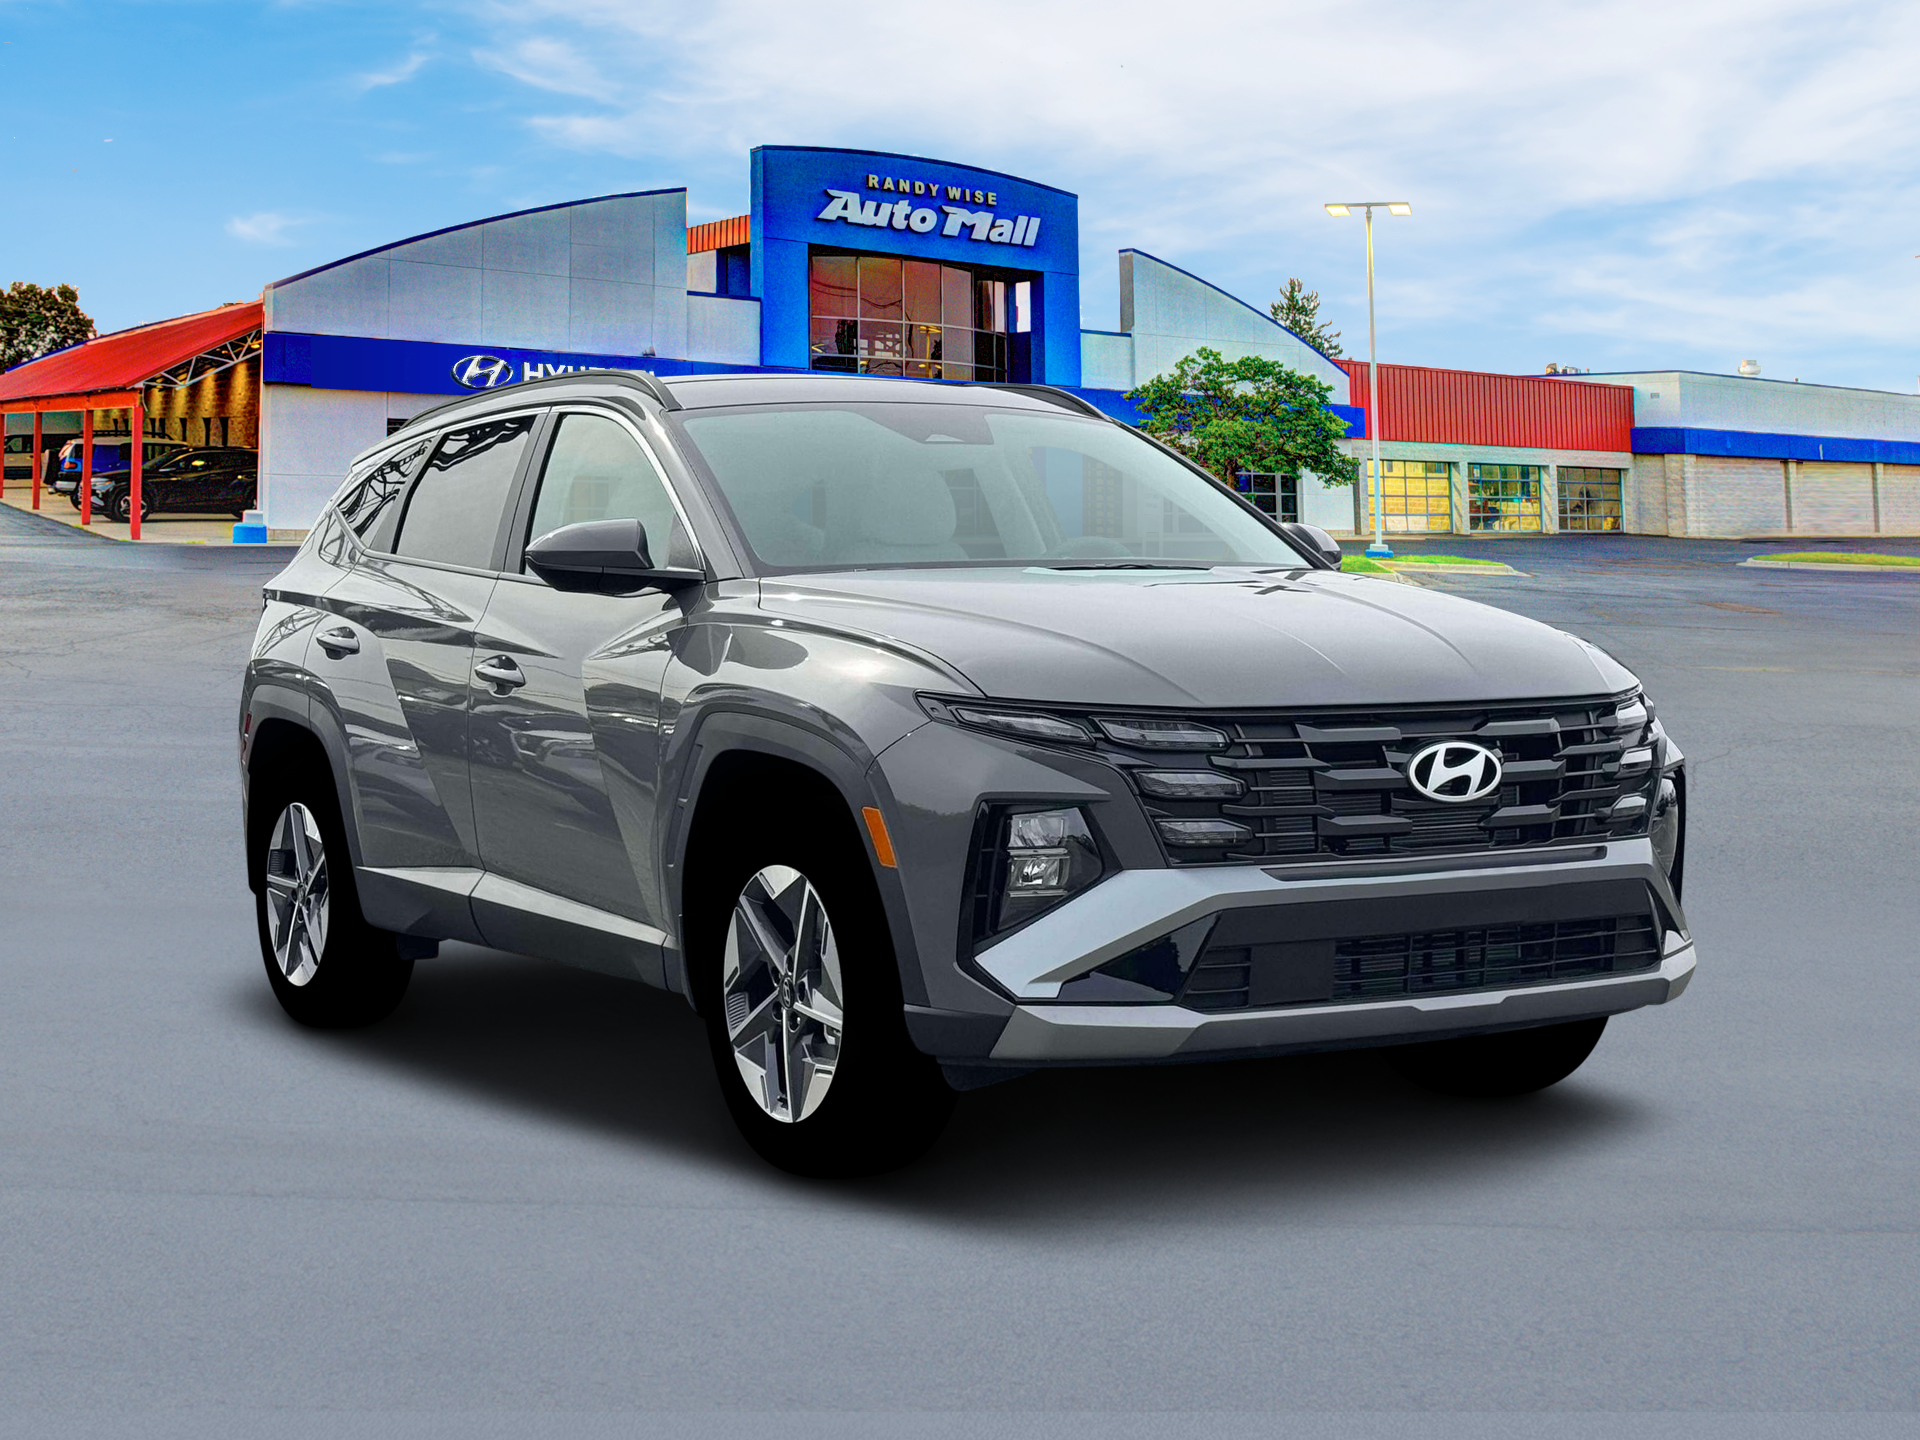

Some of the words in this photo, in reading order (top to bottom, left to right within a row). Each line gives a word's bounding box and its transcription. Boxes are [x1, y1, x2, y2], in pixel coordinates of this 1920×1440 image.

[867, 173, 939, 197] RANDY
[946, 185, 997, 206] WISE
[816, 188, 938, 233] Auto
[941, 204, 1041, 247] Mall
